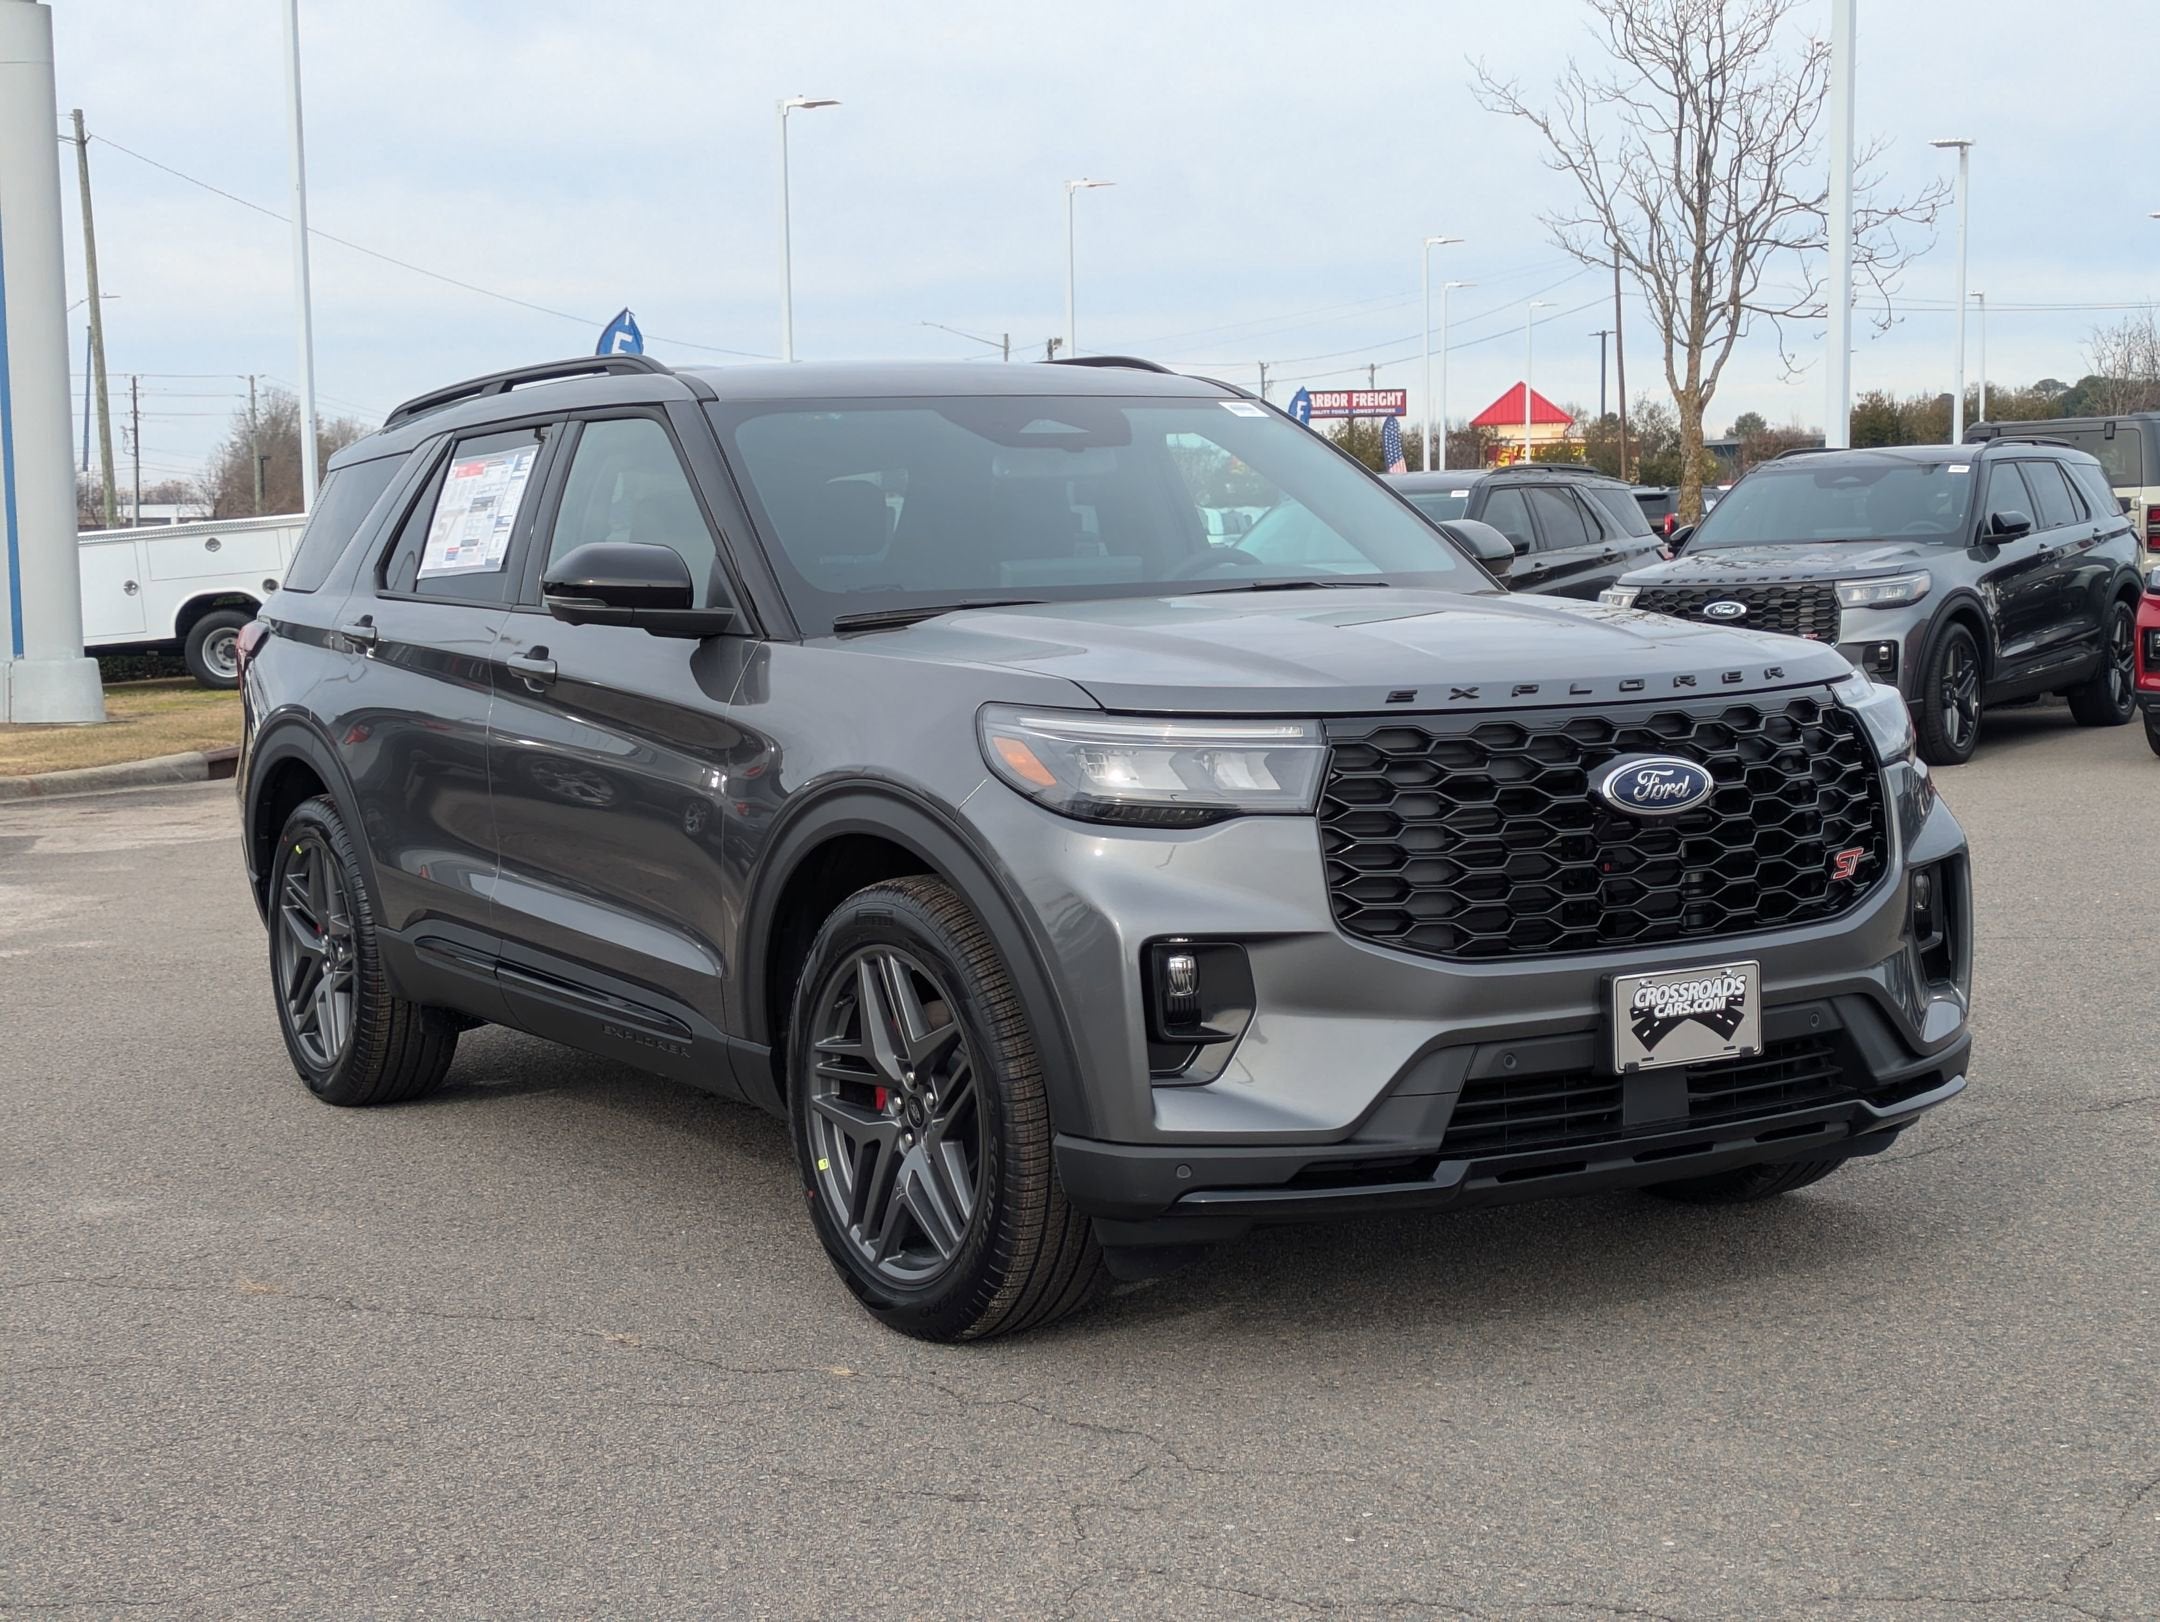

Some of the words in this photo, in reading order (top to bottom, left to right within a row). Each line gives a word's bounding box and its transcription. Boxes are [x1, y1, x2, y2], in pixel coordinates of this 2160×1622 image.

[1309, 393, 1348, 408] ARBOR
[1352, 391, 1403, 407] FREIGHT
[1385, 665, 1786, 704] EXPLORER
[1633, 769, 1691, 801] Ford
[1832, 846, 1865, 880] ST
[1633, 974, 1747, 1009] CROSSROADS
[1653, 996, 1727, 1018] CARS.COM
